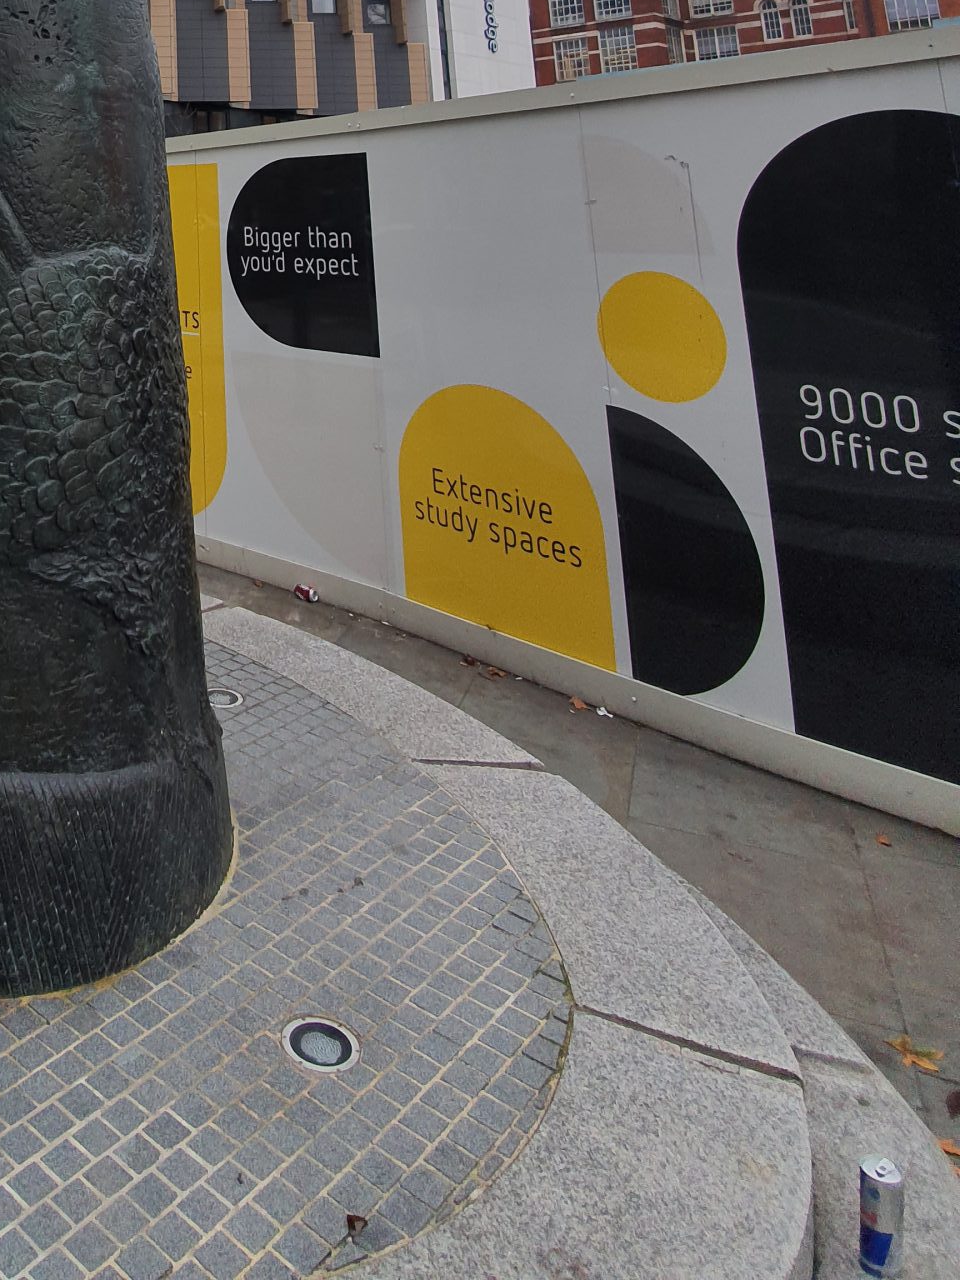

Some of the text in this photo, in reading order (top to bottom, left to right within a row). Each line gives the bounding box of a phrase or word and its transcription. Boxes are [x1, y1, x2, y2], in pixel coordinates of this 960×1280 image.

[243, 226, 352, 253] Bigger than
[240, 252, 360, 281] you'd expect
[799, 384, 920, 433] 9000
[799, 426, 929, 480] Office
[431, 467, 553, 524] Extensive
[414, 497, 582, 568] study spaces
